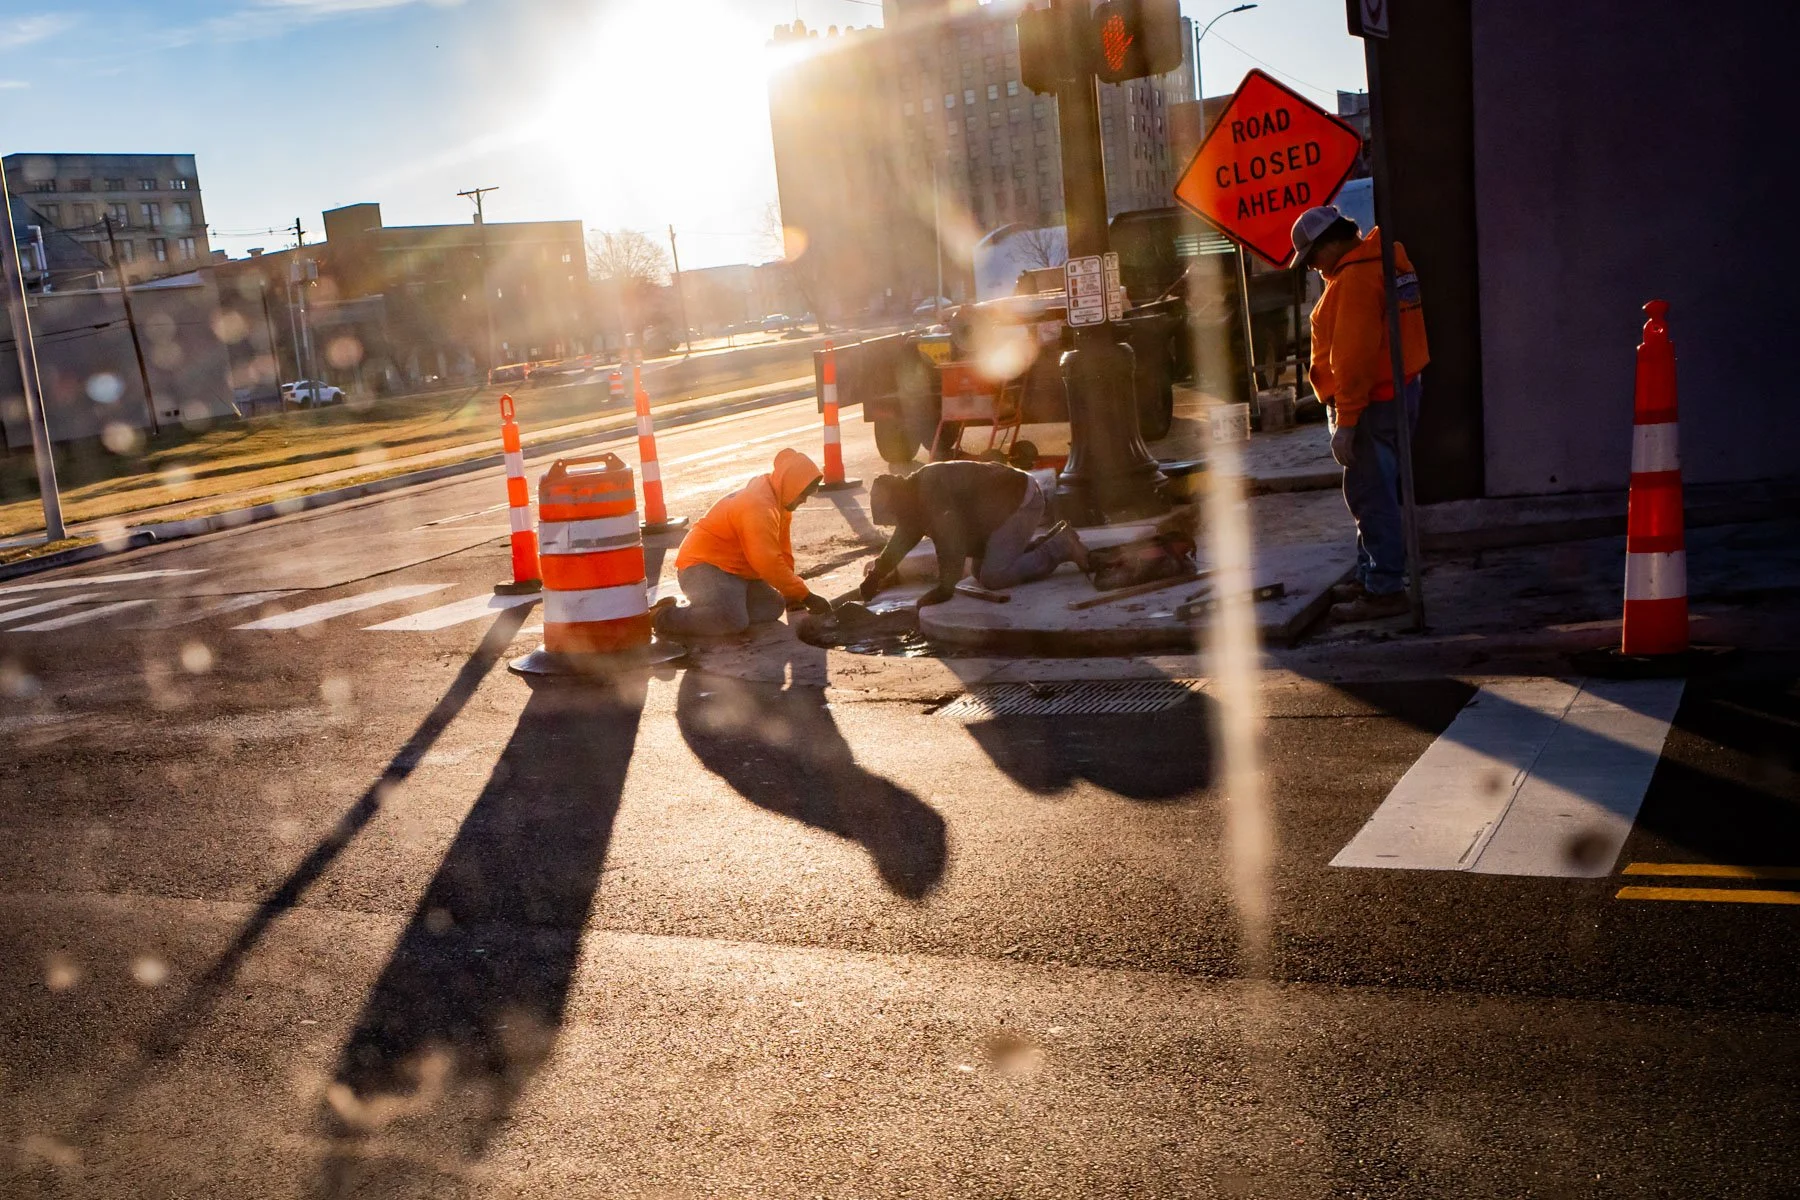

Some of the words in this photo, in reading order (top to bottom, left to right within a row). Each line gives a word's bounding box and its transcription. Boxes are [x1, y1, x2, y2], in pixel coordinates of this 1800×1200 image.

[1232, 108, 1290, 144] ROAD
[1216, 141, 1320, 188] CLOSED
[1237, 182, 1310, 220] AHEAD
